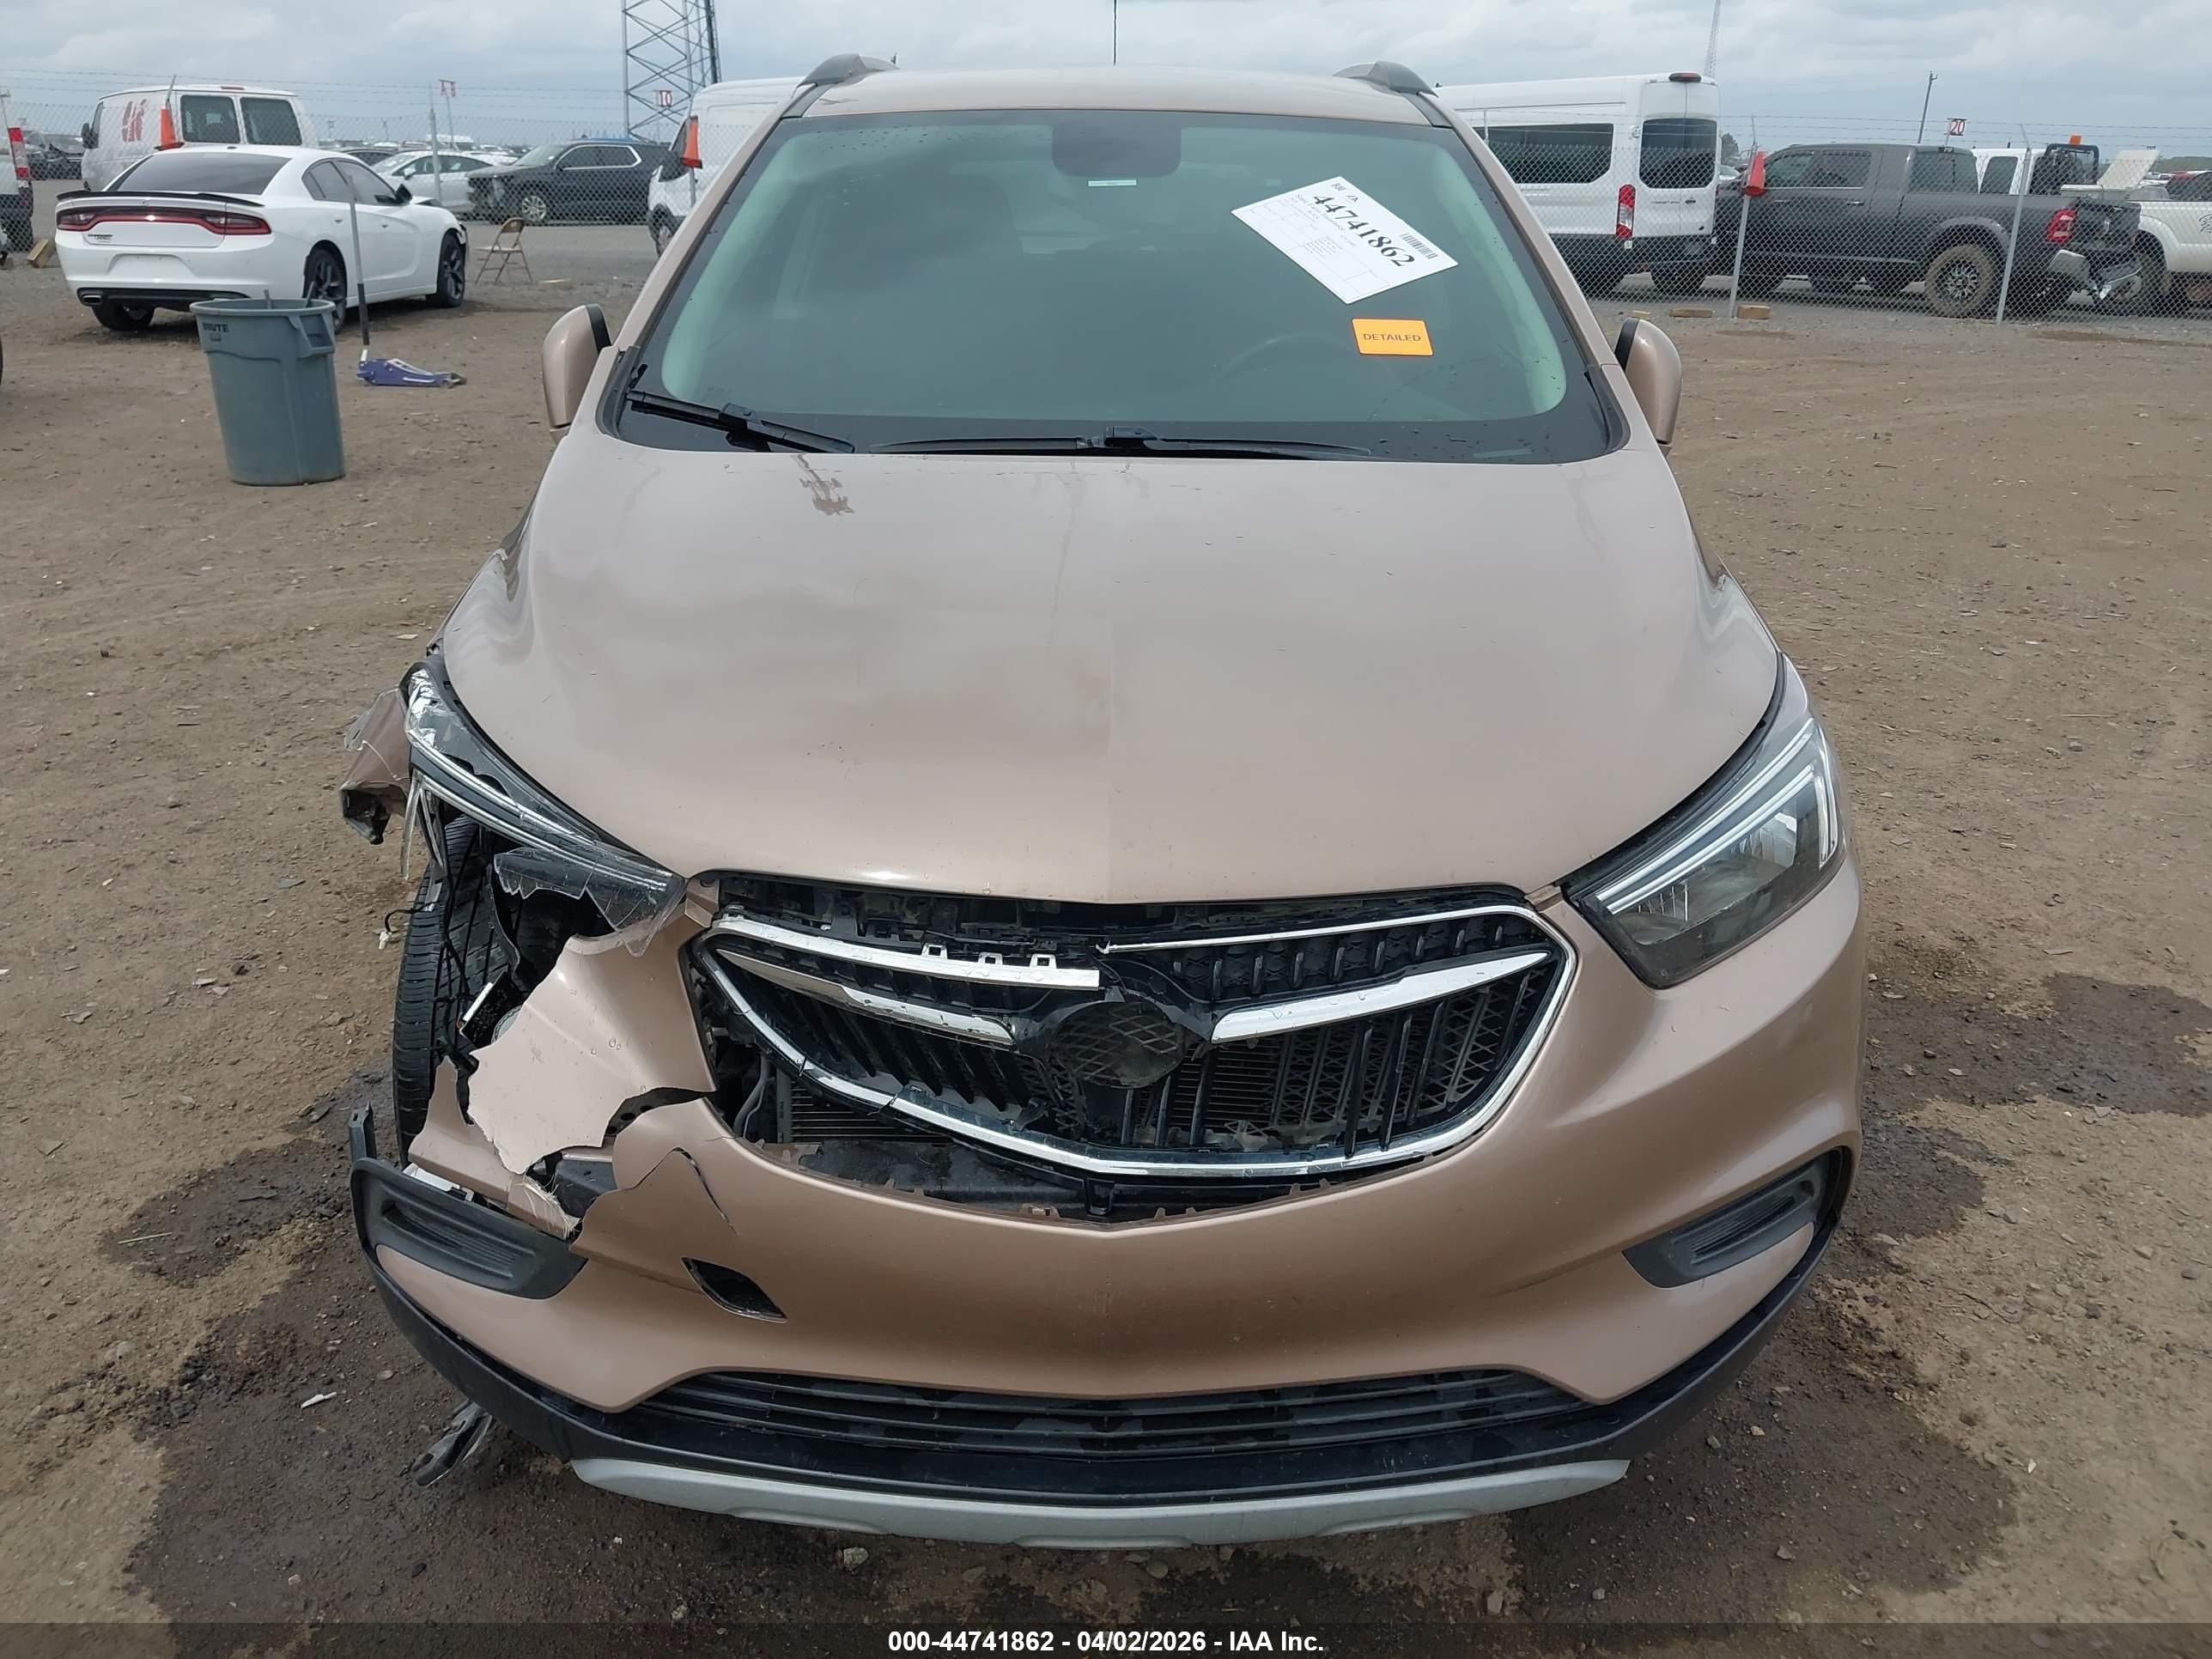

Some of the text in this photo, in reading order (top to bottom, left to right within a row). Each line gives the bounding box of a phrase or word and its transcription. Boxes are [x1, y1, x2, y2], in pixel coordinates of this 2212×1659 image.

[659, 90, 672, 106] 10
[1950, 119, 1965, 136] 20
[1312, 196, 1415, 266] 44741862
[1362, 332, 1421, 342] DETAILED
